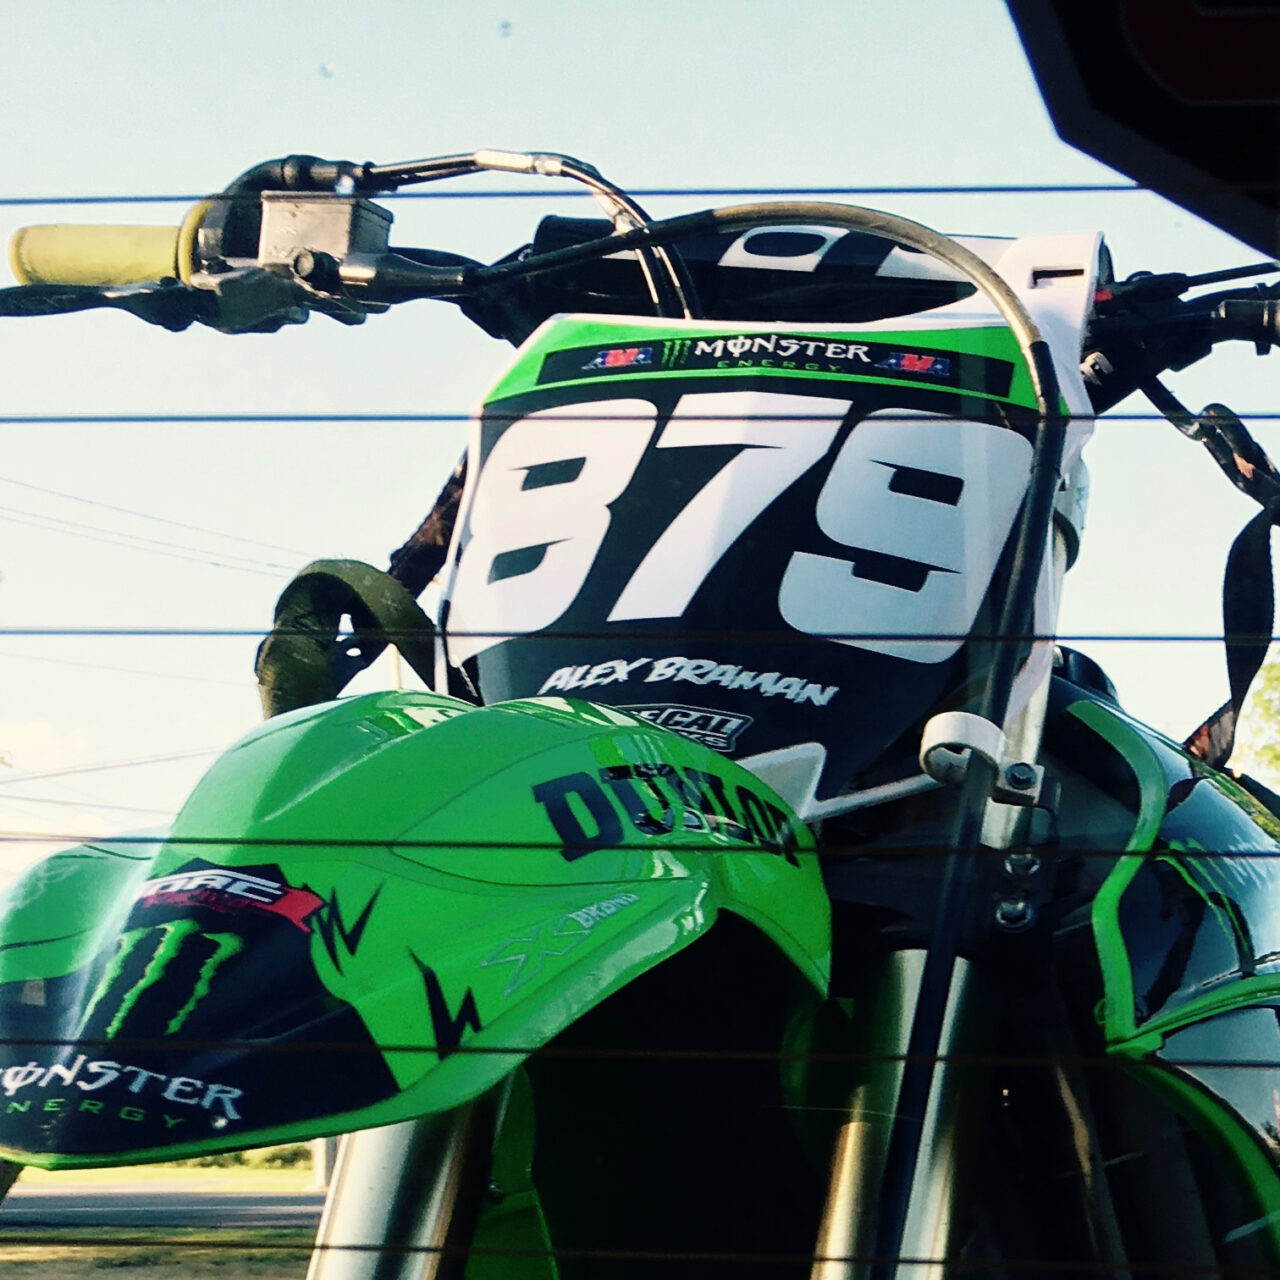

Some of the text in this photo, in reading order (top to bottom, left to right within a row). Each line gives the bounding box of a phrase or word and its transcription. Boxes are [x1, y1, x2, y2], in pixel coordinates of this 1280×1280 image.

[694, 334, 871, 362] MONSTER
[716, 358, 841, 372] ENERGY
[448, 391, 1035, 666] 879
[537, 656, 840, 706] ALEX BRAMAN
[0, 1053, 243, 1121] ONSTER
